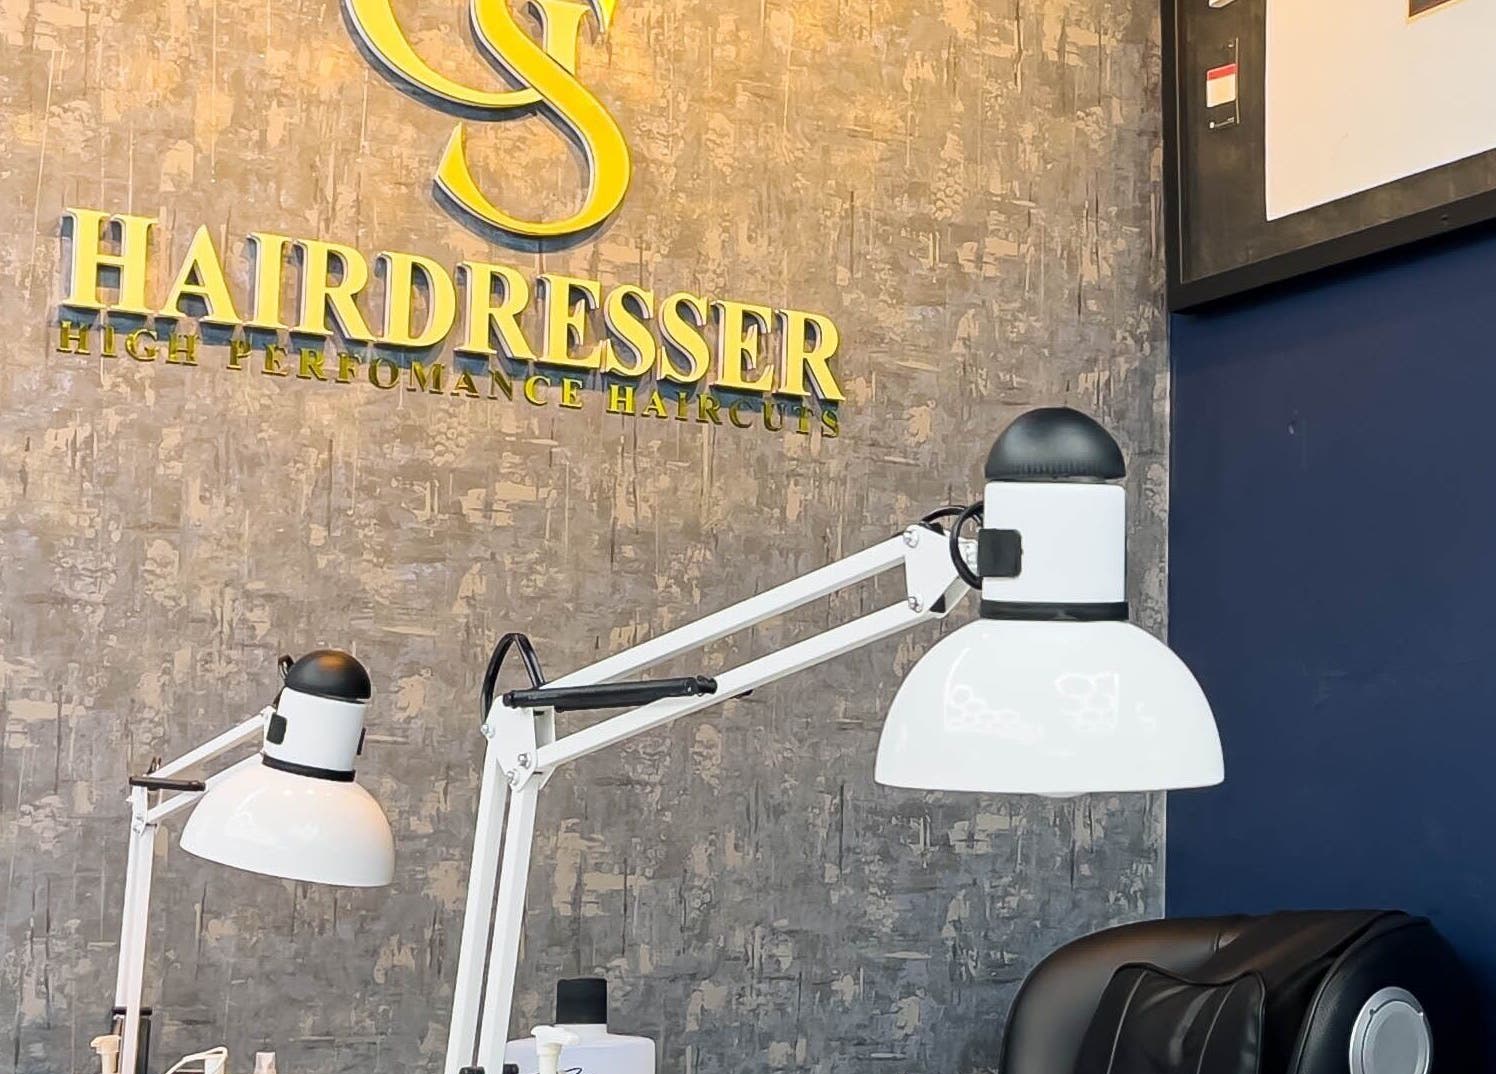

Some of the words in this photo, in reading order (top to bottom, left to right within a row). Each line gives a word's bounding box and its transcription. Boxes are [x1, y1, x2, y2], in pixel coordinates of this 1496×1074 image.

[56, 320, 199, 367] HIGH
[226, 339, 584, 409] PERFOMANCE
[606, 383, 841, 438] HAIRCUTS
[63, 207, 846, 402] HAIRDRESSER
